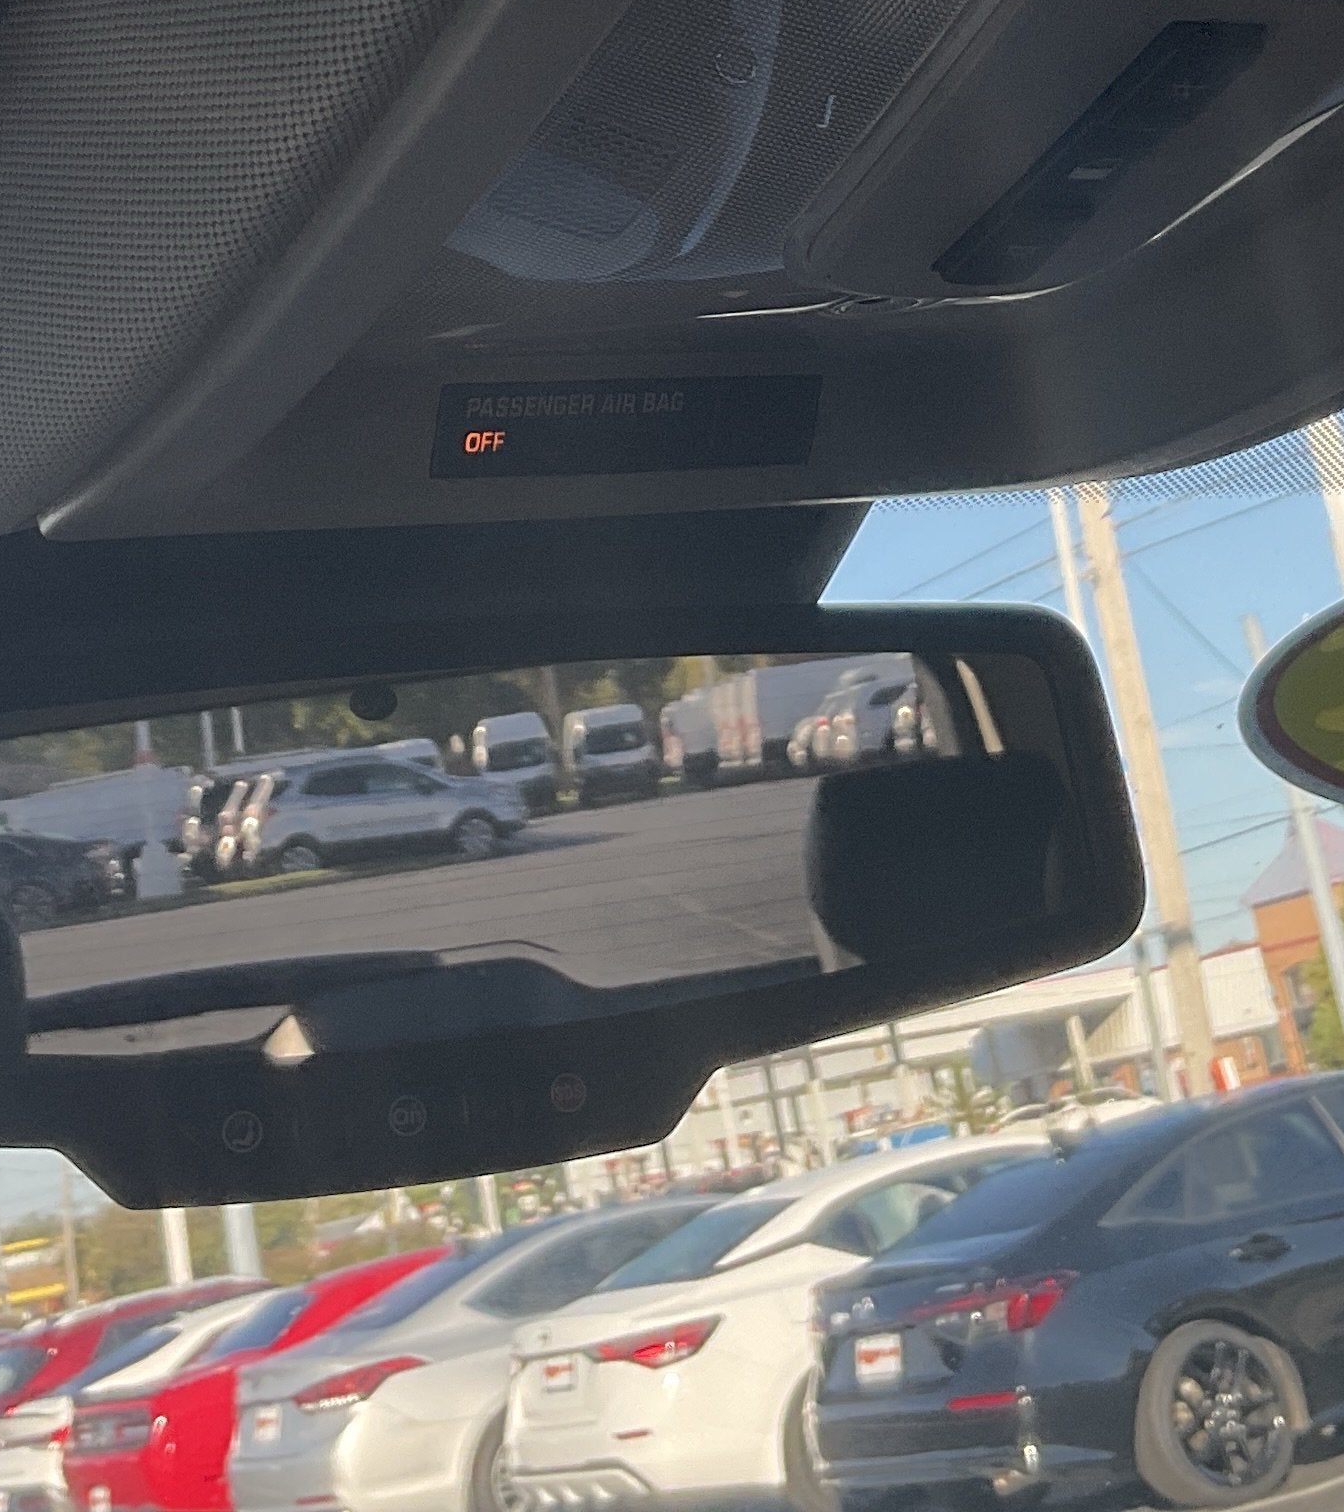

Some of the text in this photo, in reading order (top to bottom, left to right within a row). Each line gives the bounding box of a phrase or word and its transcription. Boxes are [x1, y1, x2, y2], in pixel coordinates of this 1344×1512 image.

[466, 391, 685, 419] PASSENGER AIR BAG
[465, 431, 506, 453] OFF
